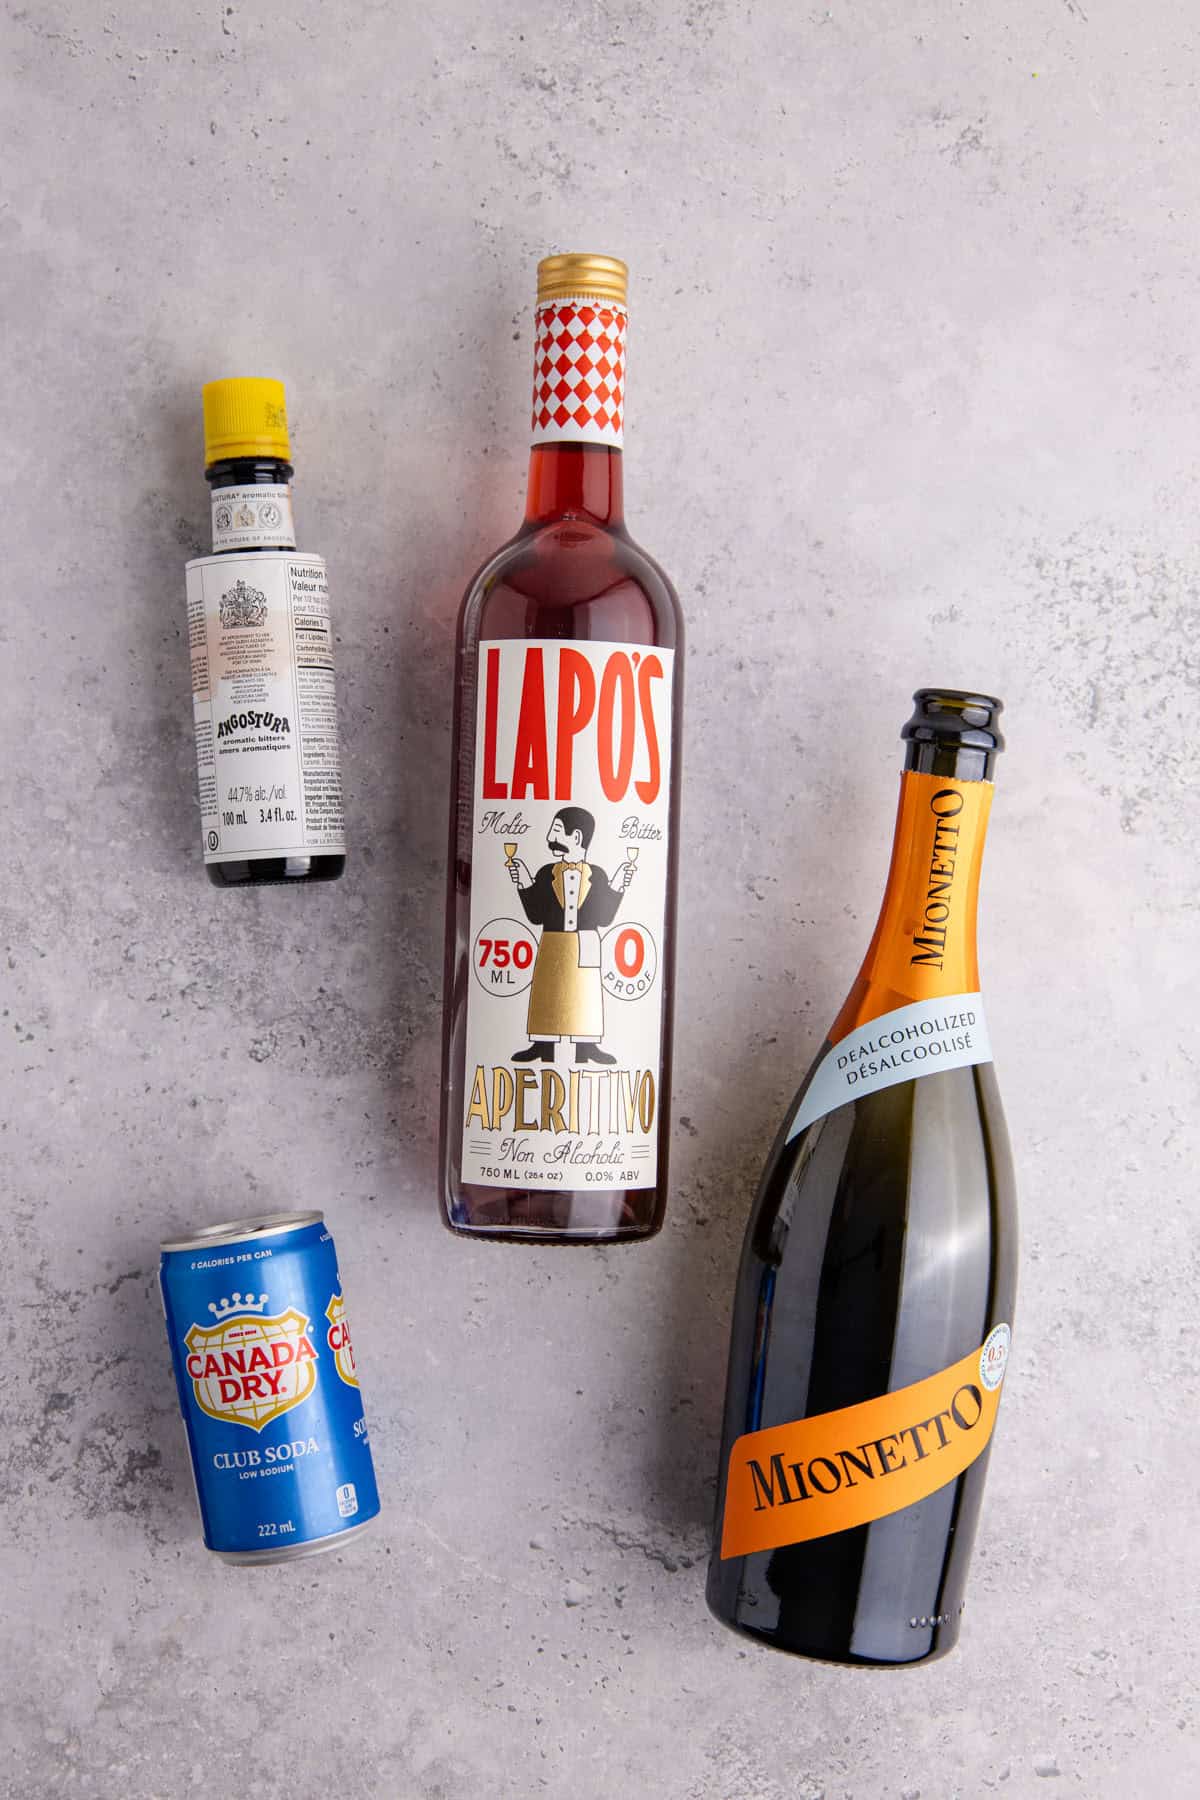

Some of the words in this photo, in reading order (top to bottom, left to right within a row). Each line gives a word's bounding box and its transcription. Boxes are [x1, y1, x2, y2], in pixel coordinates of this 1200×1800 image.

[290, 567, 324, 579] Nutrition
[292, 580, 316, 591] Valeur
[295, 617, 319, 627] Calories
[217, 710, 290, 739] ANGOSTURA
[482, 647, 664, 805] LAPO'S
[223, 736, 256, 745] aromatic
[242, 744, 291, 752] aromatiques
[228, 786, 252, 803] 44.7%
[222, 811, 235, 826] 100
[236, 810, 248, 825] mL
[260, 808, 273, 823] 3.4
[286, 810, 297, 822] oz.
[478, 811, 532, 835] Molto
[618, 816, 663, 841] Bitter
[911, 788, 964, 971] MIONETTO
[478, 939, 533, 969] 750
[614, 928, 645, 978] 0
[491, 970, 515, 984] ML
[604, 971, 652, 995] PROOF
[837, 1011, 977, 1071] DEALCOHOLIZED
[846, 1031, 973, 1086] DÉSALCOOLISÉ
[466, 1065, 656, 1135] APERITIVO
[498, 1138, 535, 1163] Non
[543, 1141, 625, 1165] Alcoholic
[480, 1167, 500, 1178] 750
[503, 1169, 521, 1180] ML
[585, 1171, 614, 1182] 0.0%
[619, 1170, 640, 1181] ABV
[197, 1257, 234, 1269] CALORIES
[237, 1252, 252, 1263] PER
[254, 1249, 272, 1260] CAN
[188, 1336, 318, 1378] CANADA
[213, 1451, 261, 1469] CLUB
[265, 1438, 320, 1464] SODA
[746, 1384, 983, 1512] MIONETTO
[240, 1470, 257, 1480] LOW
[260, 1464, 294, 1477] SODIUM
[258, 1523, 277, 1537] 222
[280, 1520, 296, 1533] mL
